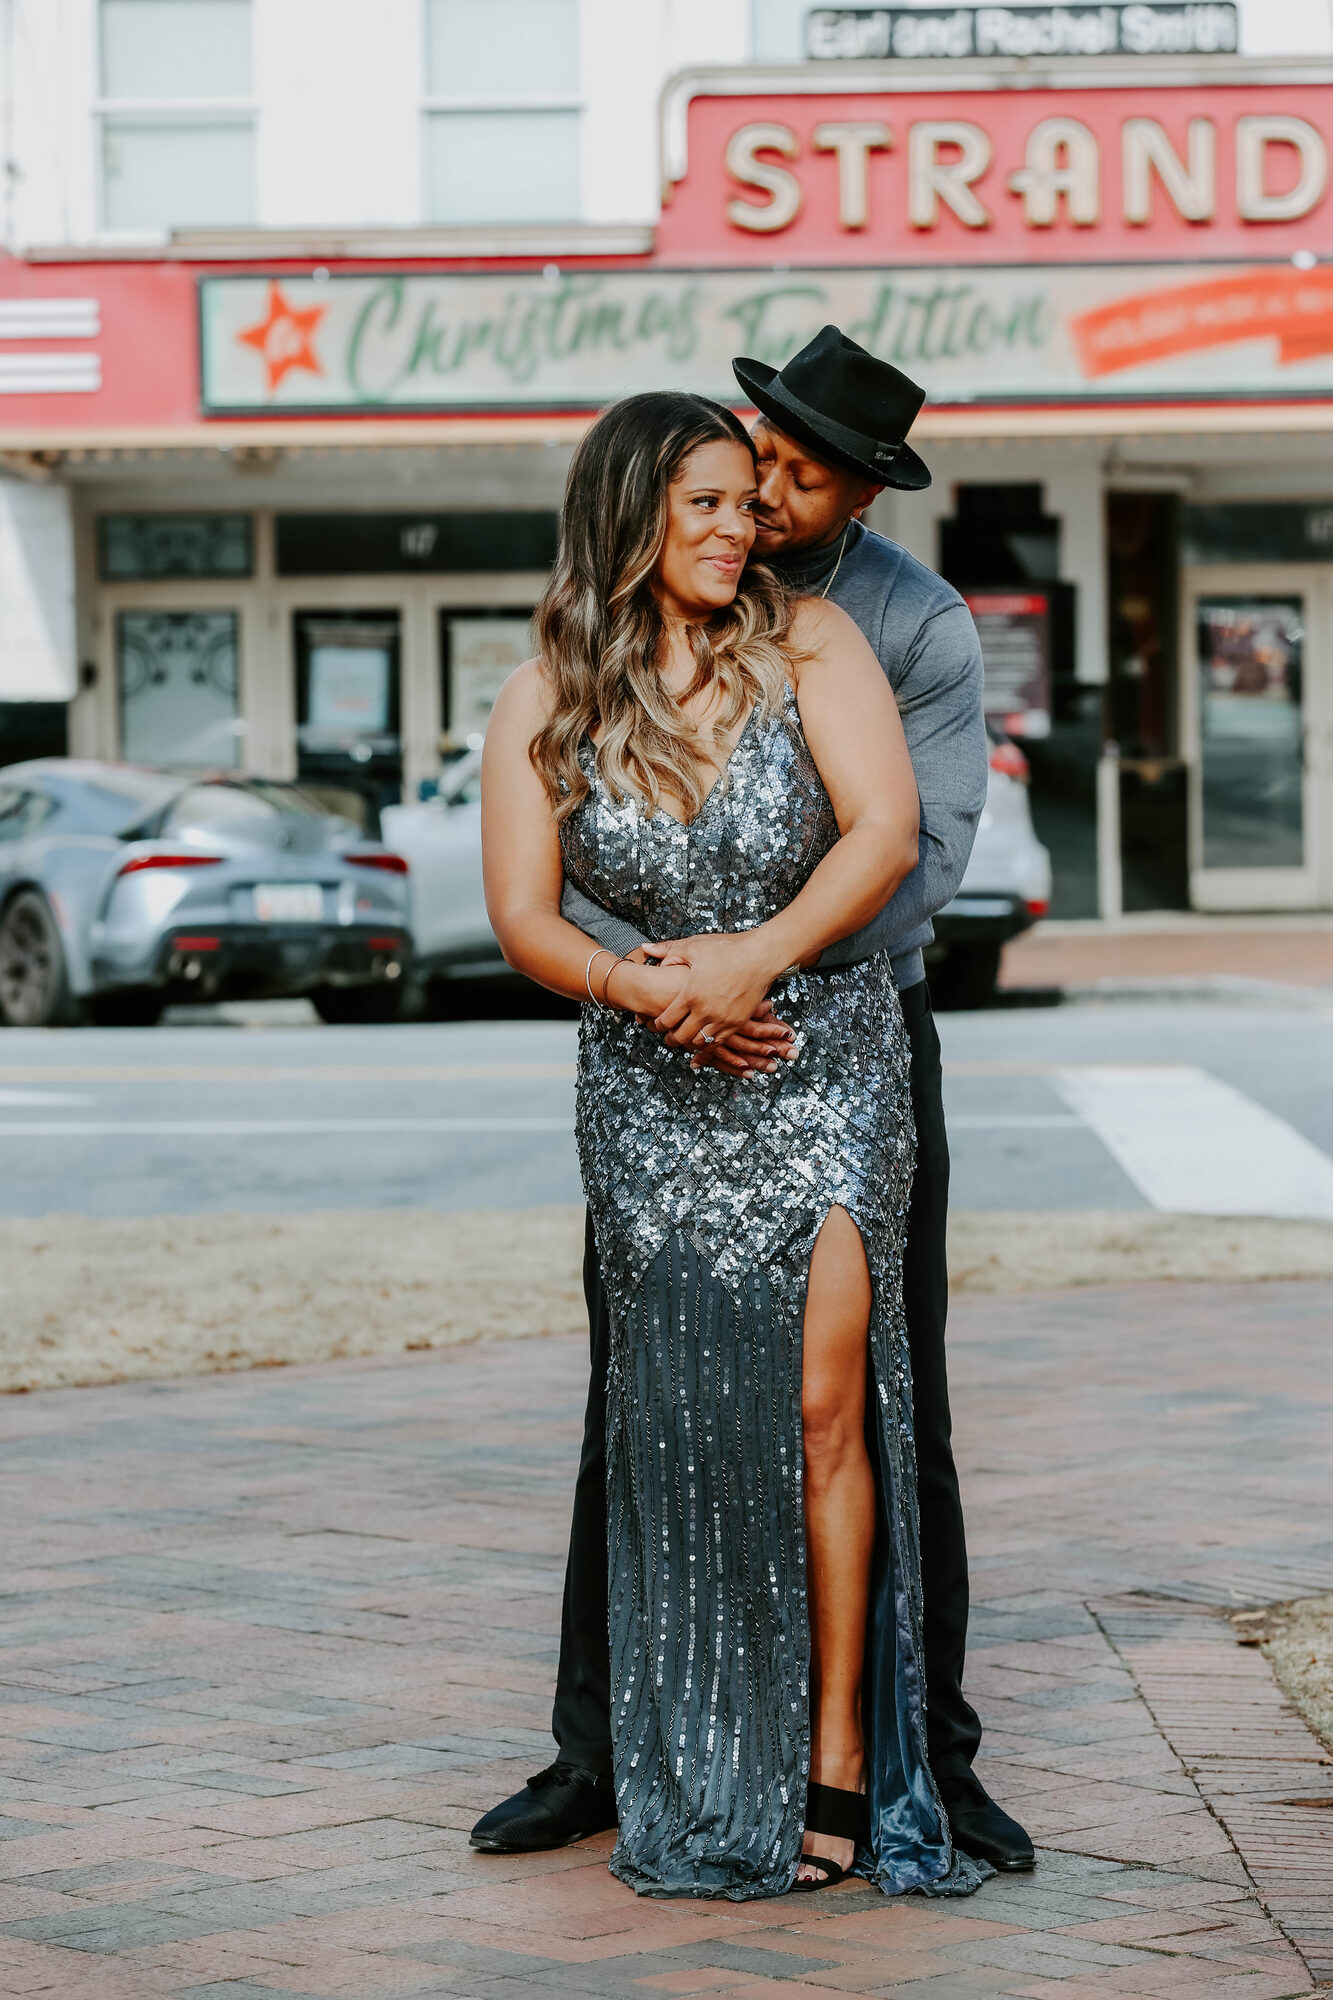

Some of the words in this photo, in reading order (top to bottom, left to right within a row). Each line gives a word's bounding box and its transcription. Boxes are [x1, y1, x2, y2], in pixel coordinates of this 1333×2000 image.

[808, 10, 891, 58] Earl
[893, 9, 974, 57] and
[976, 8, 1118, 56] Rachel
[1121, 5, 1238, 53] Smith
[726, 115, 1329, 233] STRAND
[347, 275, 702, 403] Christmas
[722, 273, 1048, 362] Trdition
